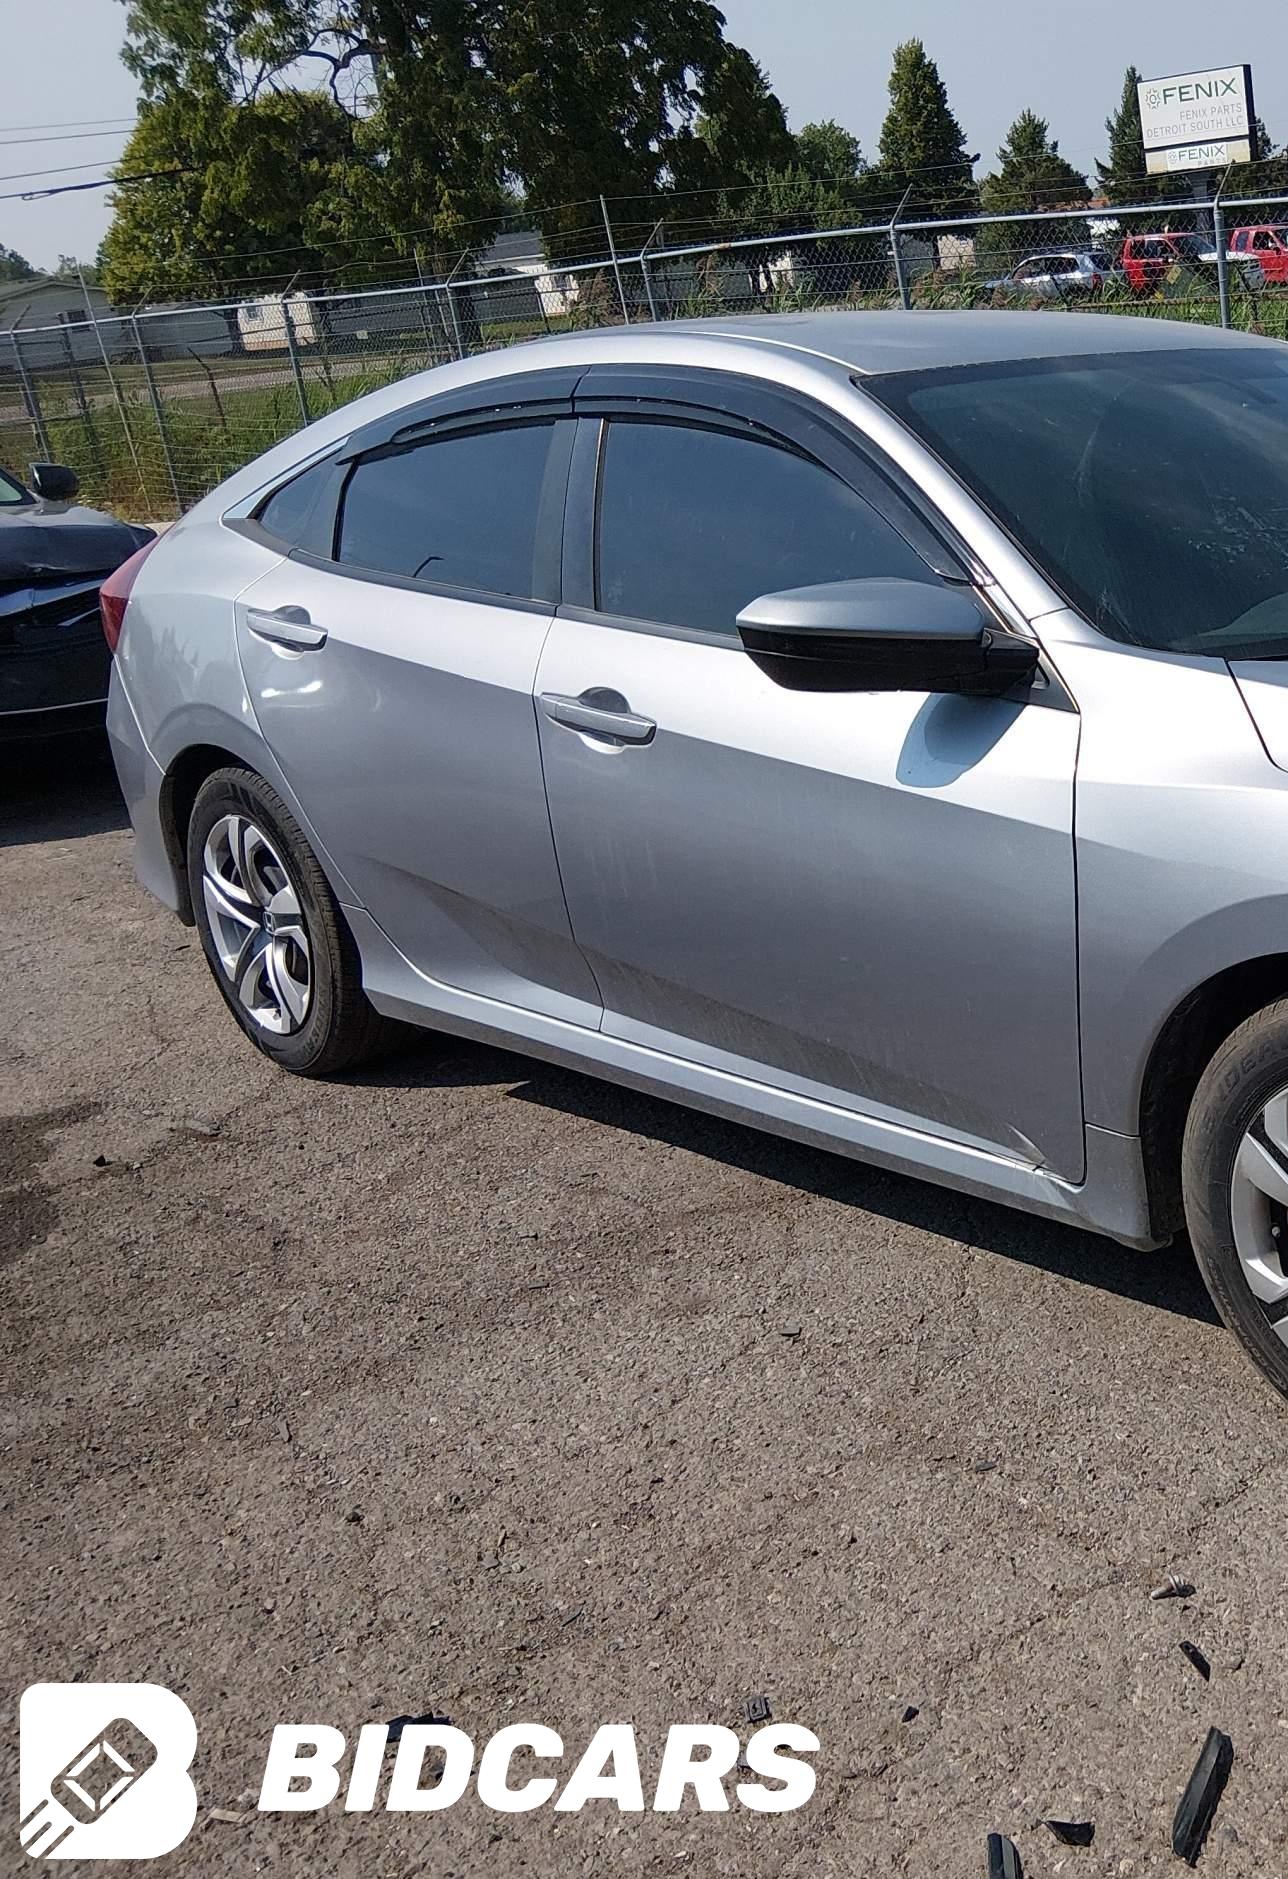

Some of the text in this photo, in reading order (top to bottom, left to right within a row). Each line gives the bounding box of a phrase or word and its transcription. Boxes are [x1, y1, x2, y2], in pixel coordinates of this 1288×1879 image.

[1163, 78, 1237, 104] FENIX
[1180, 103, 1242, 121] FENIX PARTS
[1147, 115, 1244, 138] DETROIT SOUTH LLC
[1178, 144, 1225, 161] FENIX
